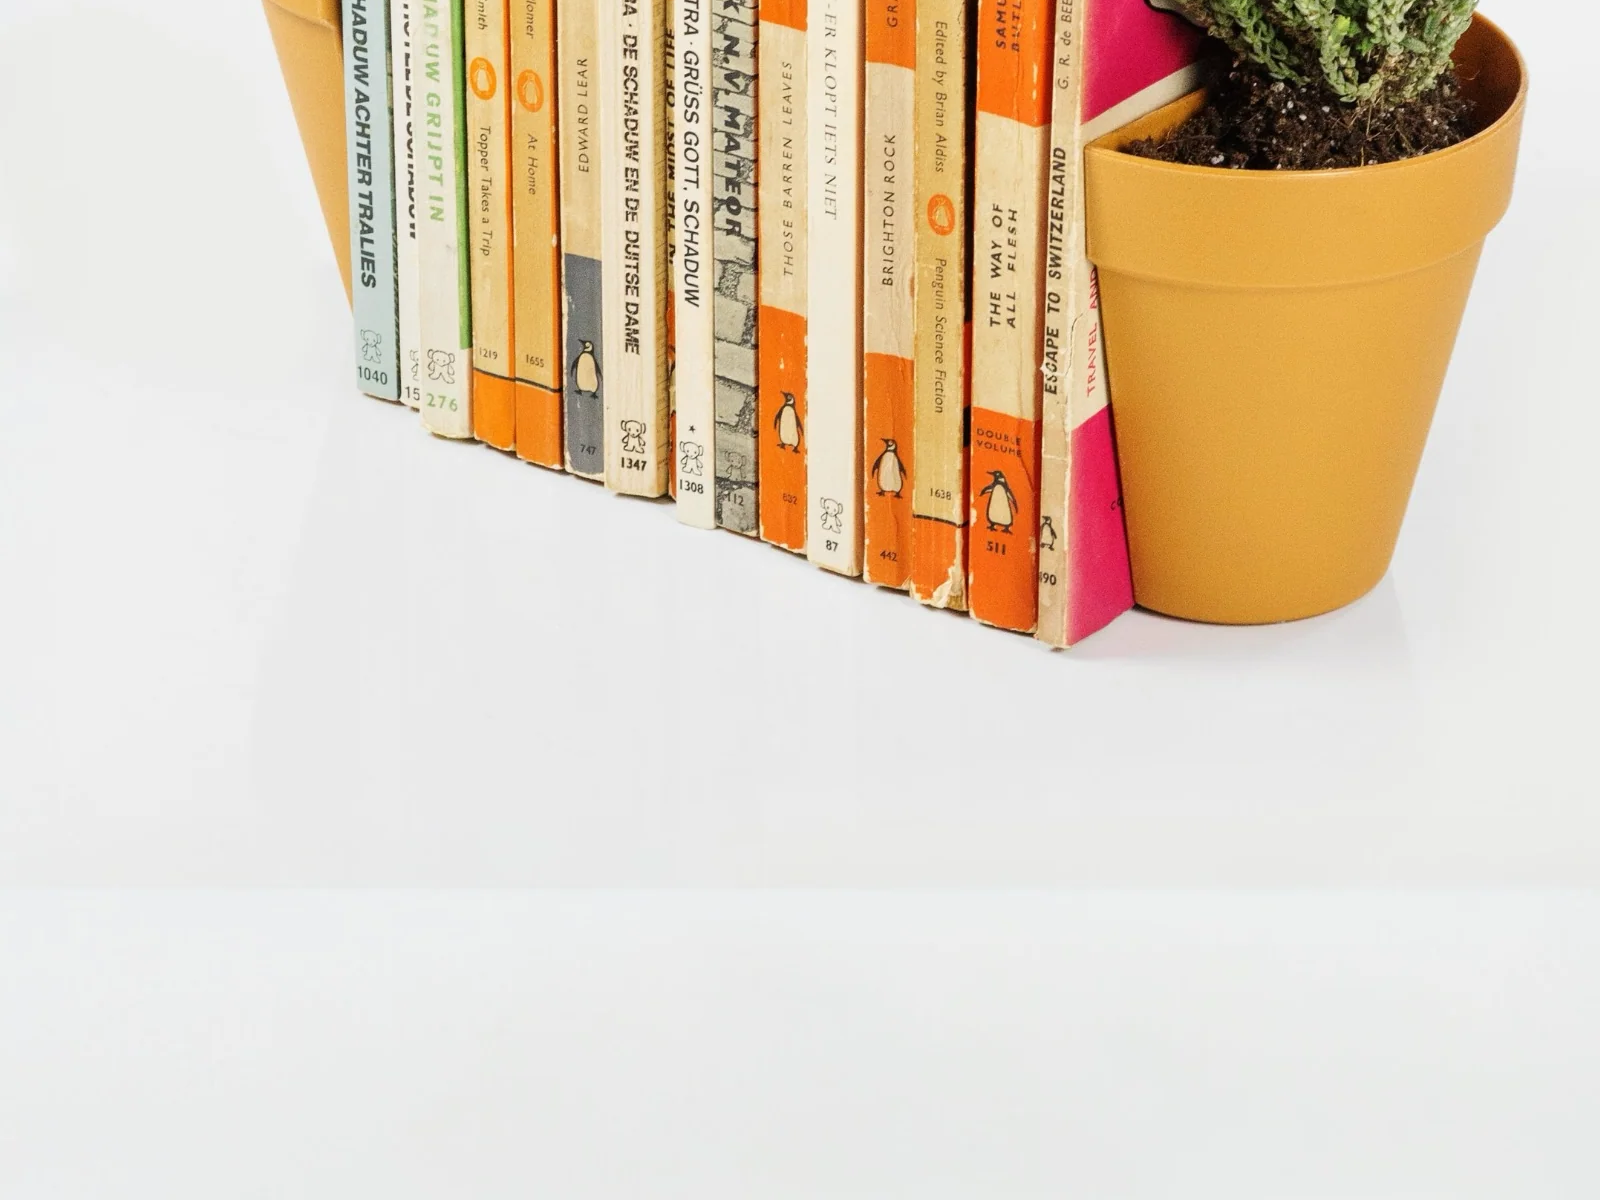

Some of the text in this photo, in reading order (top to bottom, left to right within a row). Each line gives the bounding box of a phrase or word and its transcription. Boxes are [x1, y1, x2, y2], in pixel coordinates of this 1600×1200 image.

[622, 33, 638, 60] DE
[1059, 54, 1070, 66] R.
[1060, 30, 1072, 45] de
[683, 50, 702, 124] GRÜSS
[824, 48, 837, 118] KLOPT
[932, 20, 948, 173] Edited by Brian Aldiss
[1058, 76, 1070, 90] G.
[577, 58, 589, 173] EDWARD LEAR
[623, 65, 639, 163] SCHADUW
[354, 88, 373, 188] ACHTER
[426, 92, 444, 188] GRIJPT
[477, 126, 491, 171] Topper
[683, 131, 700, 190] GOTT,
[824, 123, 837, 166] IETS
[528, 133, 538, 195] At Home
[624, 167, 639, 192] EN
[724, 105, 742, 237] MATEOR
[782, 61, 793, 277] THOSE BARREN LEAVES
[429, 195, 445, 222] IN
[481, 177, 492, 212] Takes
[625, 197, 640, 223] DE
[824, 173, 837, 220] NIET
[881, 134, 896, 286] BRIGHTON ROCK
[358, 190, 377, 288] TRALIES
[480, 230, 493, 256] Trip
[684, 199, 700, 308] SCHADUW
[625, 230, 640, 298] DUITSE
[989, 203, 1004, 327] THE WAY OF
[1006, 209, 1018, 329] ALL FLESH
[1045, 147, 1066, 394] ESCAPE TO SWITZERLAND
[625, 302, 640, 356] DAME
[931, 258, 948, 414] Penguin Science Fiction
[357, 365, 388, 385] 1040
[478, 347, 498, 360] 1219
[525, 354, 545, 368] 1655
[1086, 323, 1098, 398] TRAVEL
[426, 393, 458, 412] 276
[580, 444, 596, 455] 747
[620, 457, 647, 471] 1347
[976, 439, 1022, 458] VOLUME
[679, 479, 704, 494] 1308
[929, 487, 952, 500] 1638
[825, 540, 838, 552] 87
[880, 550, 897, 561] 442
[986, 541, 1006, 555] 511
